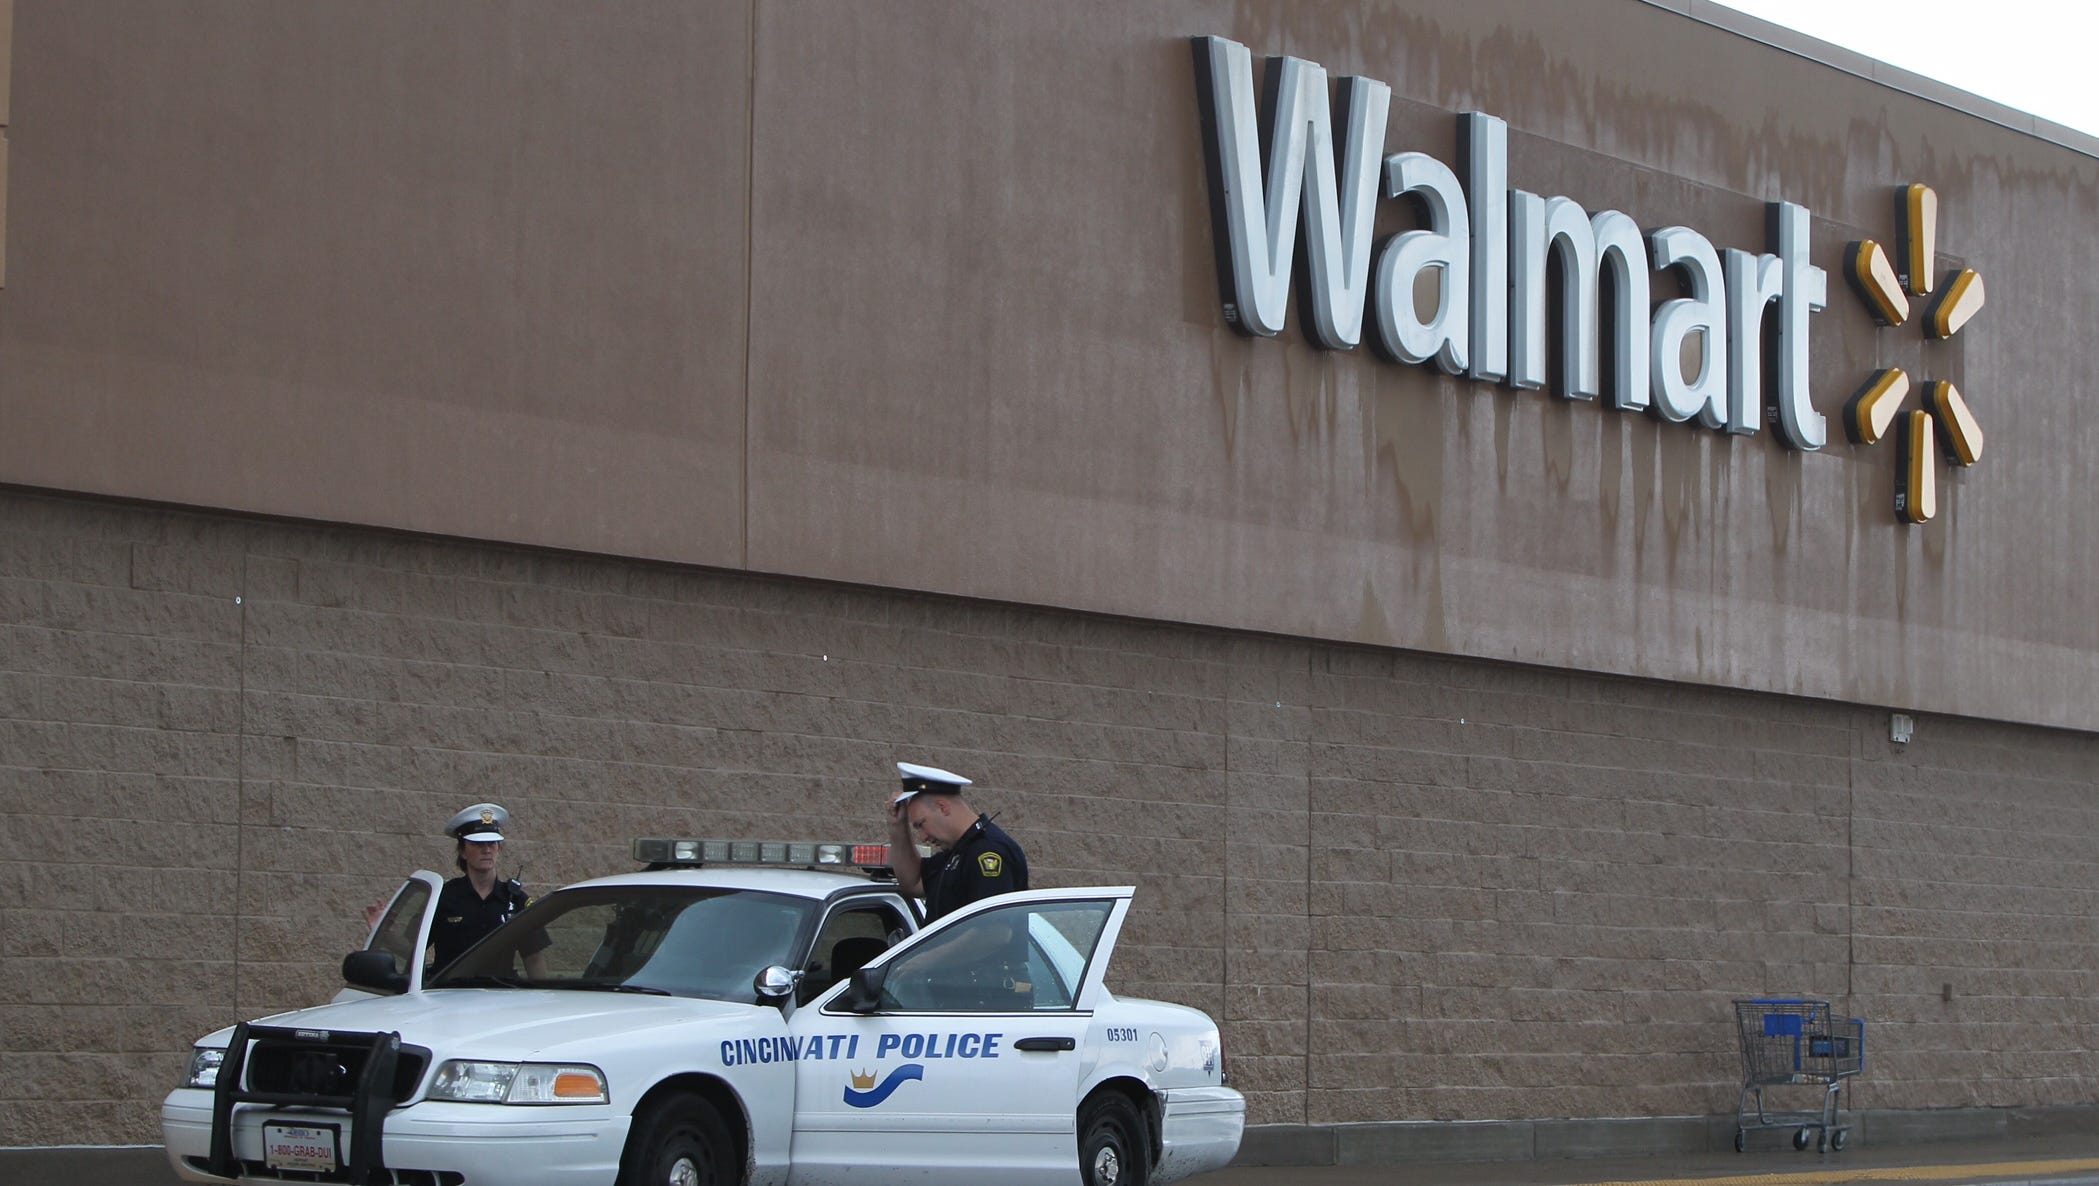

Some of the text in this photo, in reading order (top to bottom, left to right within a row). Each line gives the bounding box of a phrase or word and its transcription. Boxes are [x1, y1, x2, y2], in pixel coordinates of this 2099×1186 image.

[1192, 36, 1827, 450] Walmart
[1107, 1028, 1138, 1041] 05301
[876, 1033, 1003, 1058] POLICE
[270, 1144, 332, 1159] 1-800-GRAB-DUI
